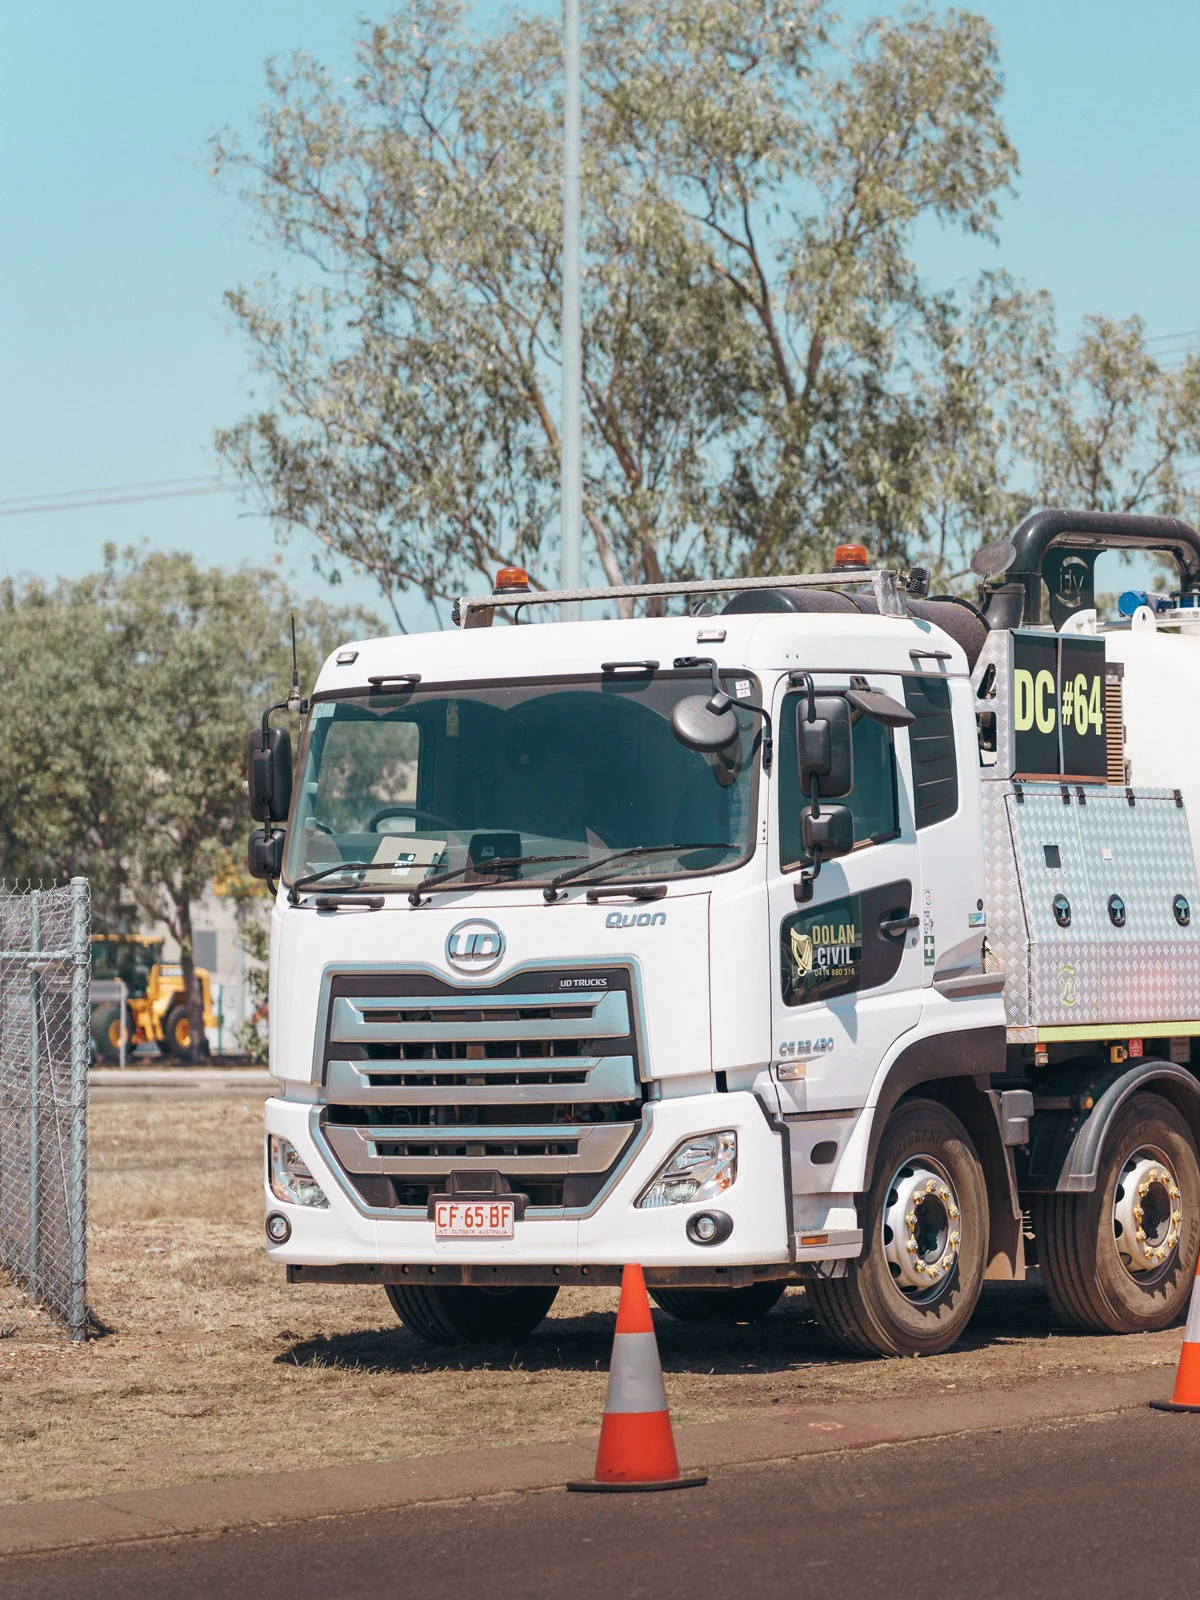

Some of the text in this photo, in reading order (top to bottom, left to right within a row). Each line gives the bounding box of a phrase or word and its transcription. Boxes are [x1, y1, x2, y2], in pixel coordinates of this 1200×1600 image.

[1014, 668, 1103, 736] DC #64
[605, 911, 667, 929] Quon
[812, 924, 855, 945] DOLAN
[450, 933, 500, 961] UD
[817, 946, 853, 967] CIVIL
[844, 967, 856, 976] 316
[560, 978, 607, 988] UD TRUCKS
